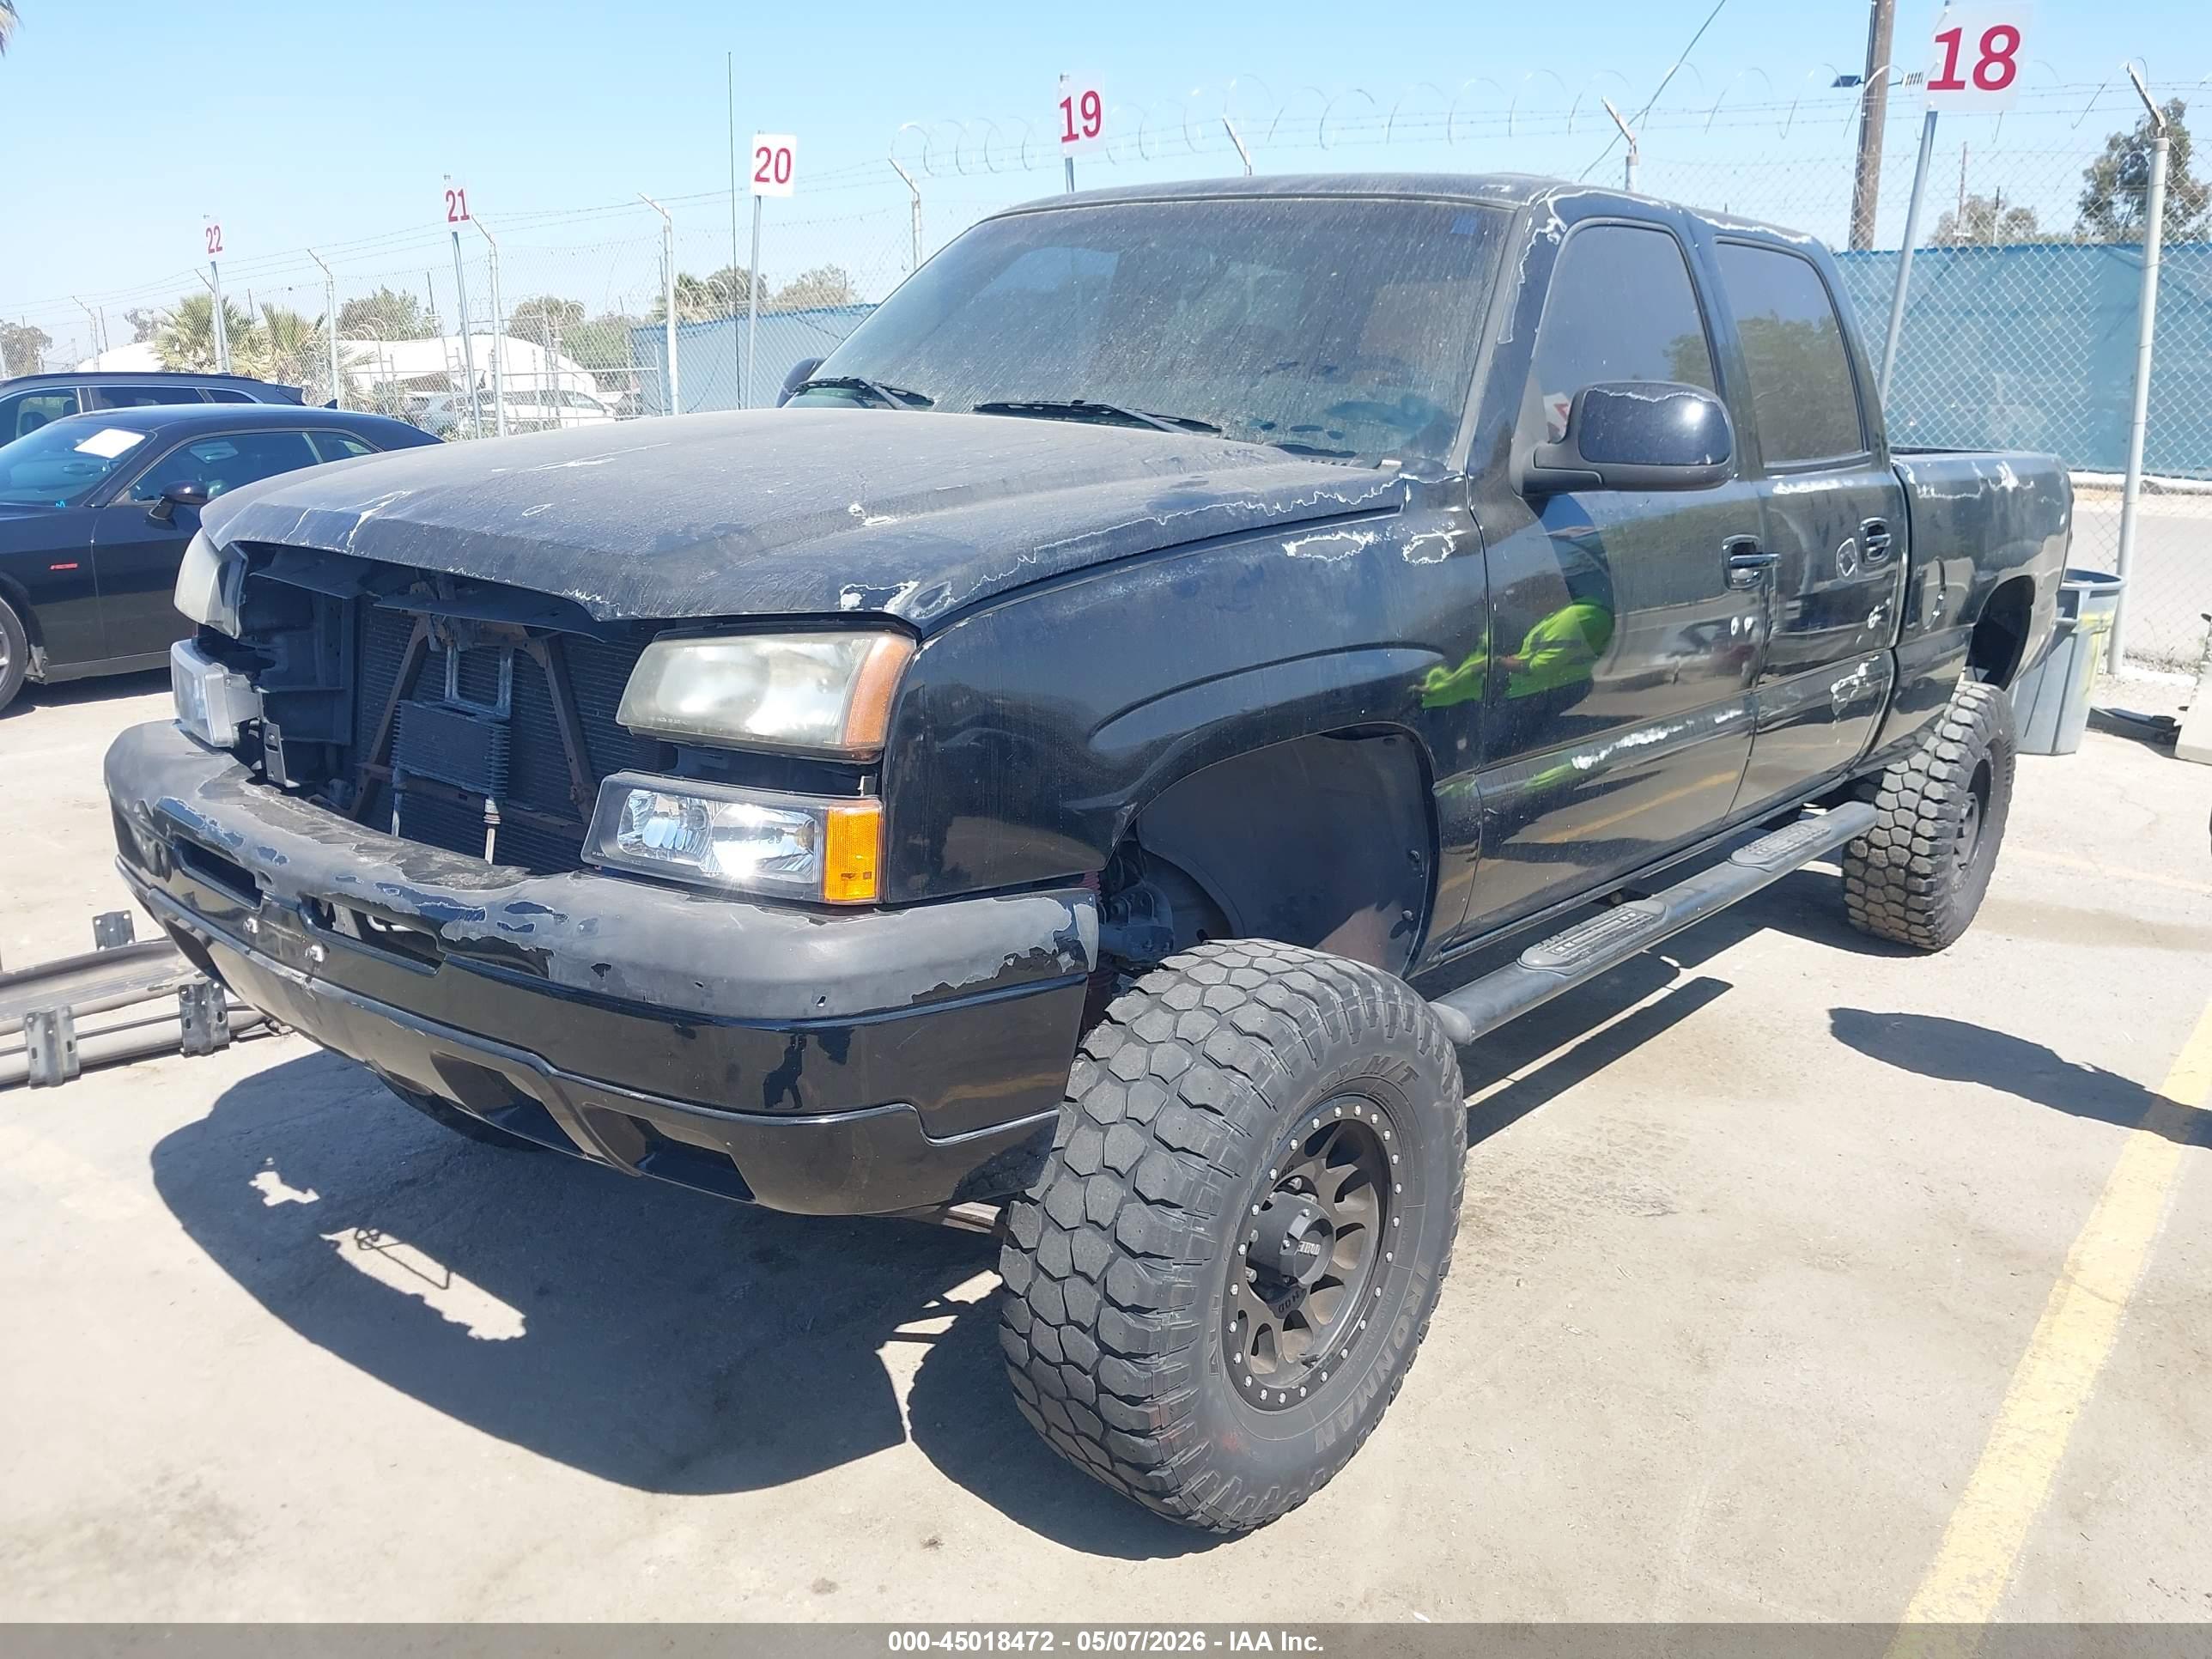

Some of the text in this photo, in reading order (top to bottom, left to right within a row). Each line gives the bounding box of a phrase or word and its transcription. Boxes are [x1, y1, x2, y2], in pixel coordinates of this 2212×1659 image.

[1926, 23, 2022, 92] 18
[1059, 89, 1103, 143] 19
[755, 146, 793, 185] 20
[445, 190, 470, 224] 21
[206, 225, 222, 254] 22
[1315, 1261, 1431, 1454] IRONMAN
